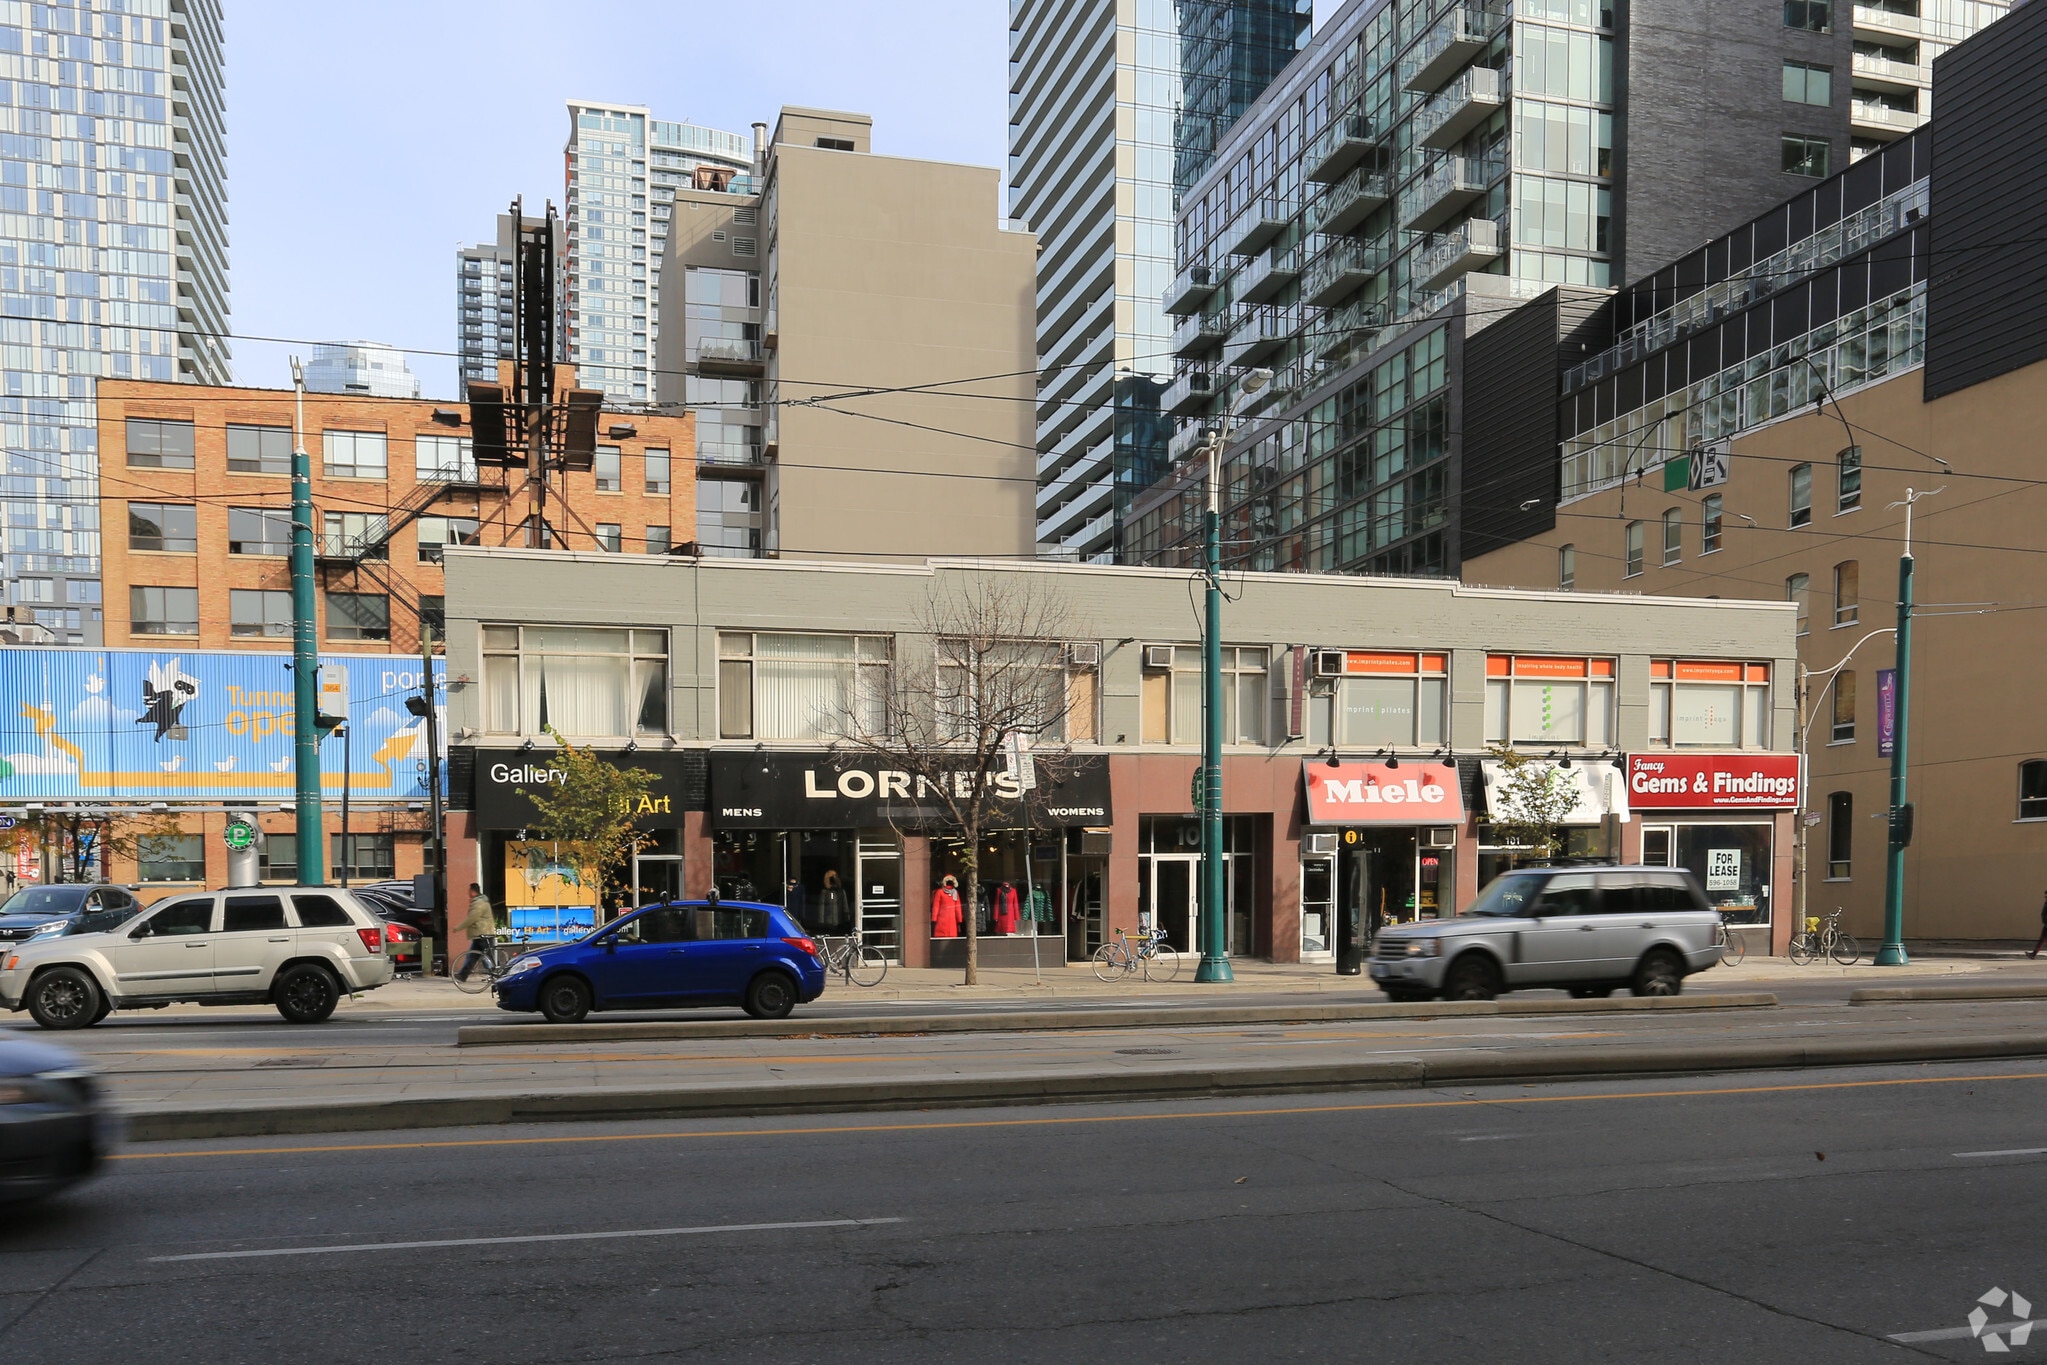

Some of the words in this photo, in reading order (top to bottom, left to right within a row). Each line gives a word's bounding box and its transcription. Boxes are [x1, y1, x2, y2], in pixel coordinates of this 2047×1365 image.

[1381, 706, 1411, 715] pilates
[1633, 759, 1665, 774] Fancy
[490, 763, 568, 786] Gallery
[804, 769, 1026, 798] LORNE'S
[1632, 772, 1688, 794] Gems
[1692, 772, 1708, 793] &
[1713, 772, 1795, 796] Findings
[1323, 779, 1445, 803] Miele
[637, 794, 671, 814] Art
[1713, 796, 1795, 804] www.GemsAndFindings.com
[722, 808, 763, 817] MENS
[1047, 807, 1105, 816] WOMENS
[1421, 857, 1439, 867] OPEN
[1716, 853, 1733, 864] FOR
[1709, 865, 1738, 876] LEASE
[494, 926, 521, 936] allery
